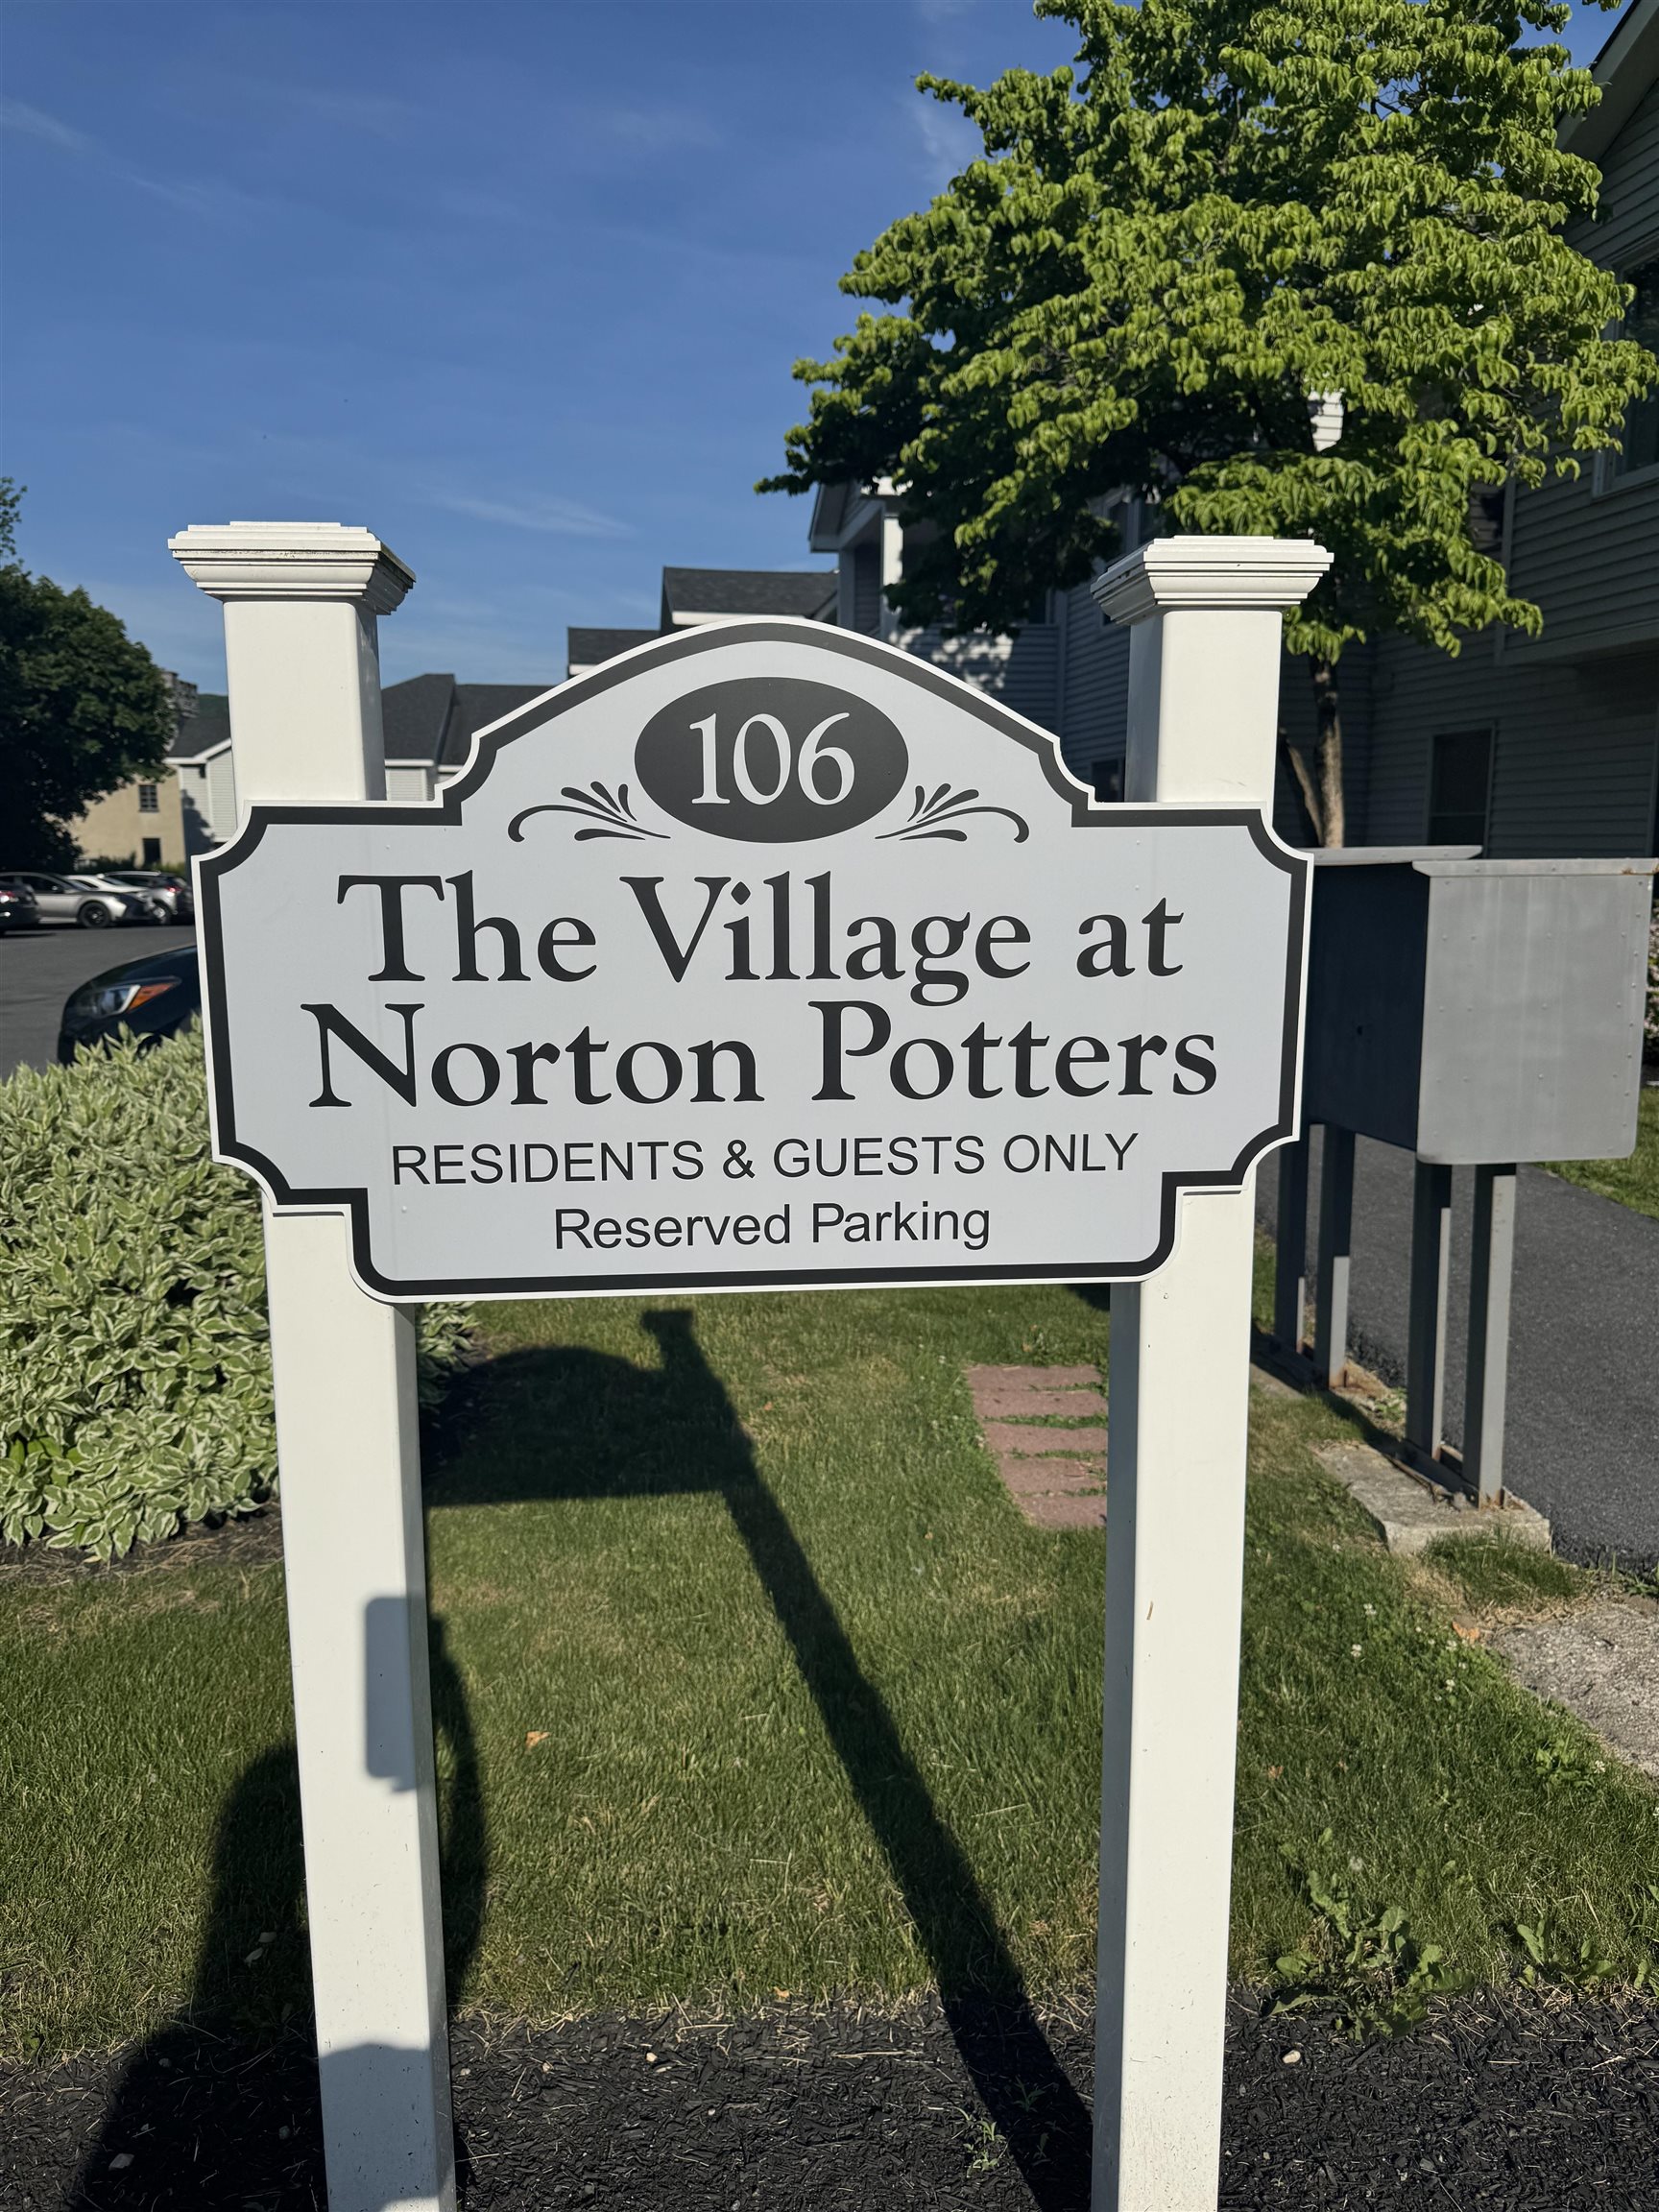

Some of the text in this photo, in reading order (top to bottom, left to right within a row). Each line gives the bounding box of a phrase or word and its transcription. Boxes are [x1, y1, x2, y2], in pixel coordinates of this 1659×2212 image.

[689, 712, 855, 807] 106
[337, 870, 1184, 1007] The Village at
[301, 1001, 1216, 1108] Norton Potters
[392, 1133, 1139, 1186] RESIDENTS & GUESTS ONLY
[555, 1202, 990, 1251] Reserved Parking
